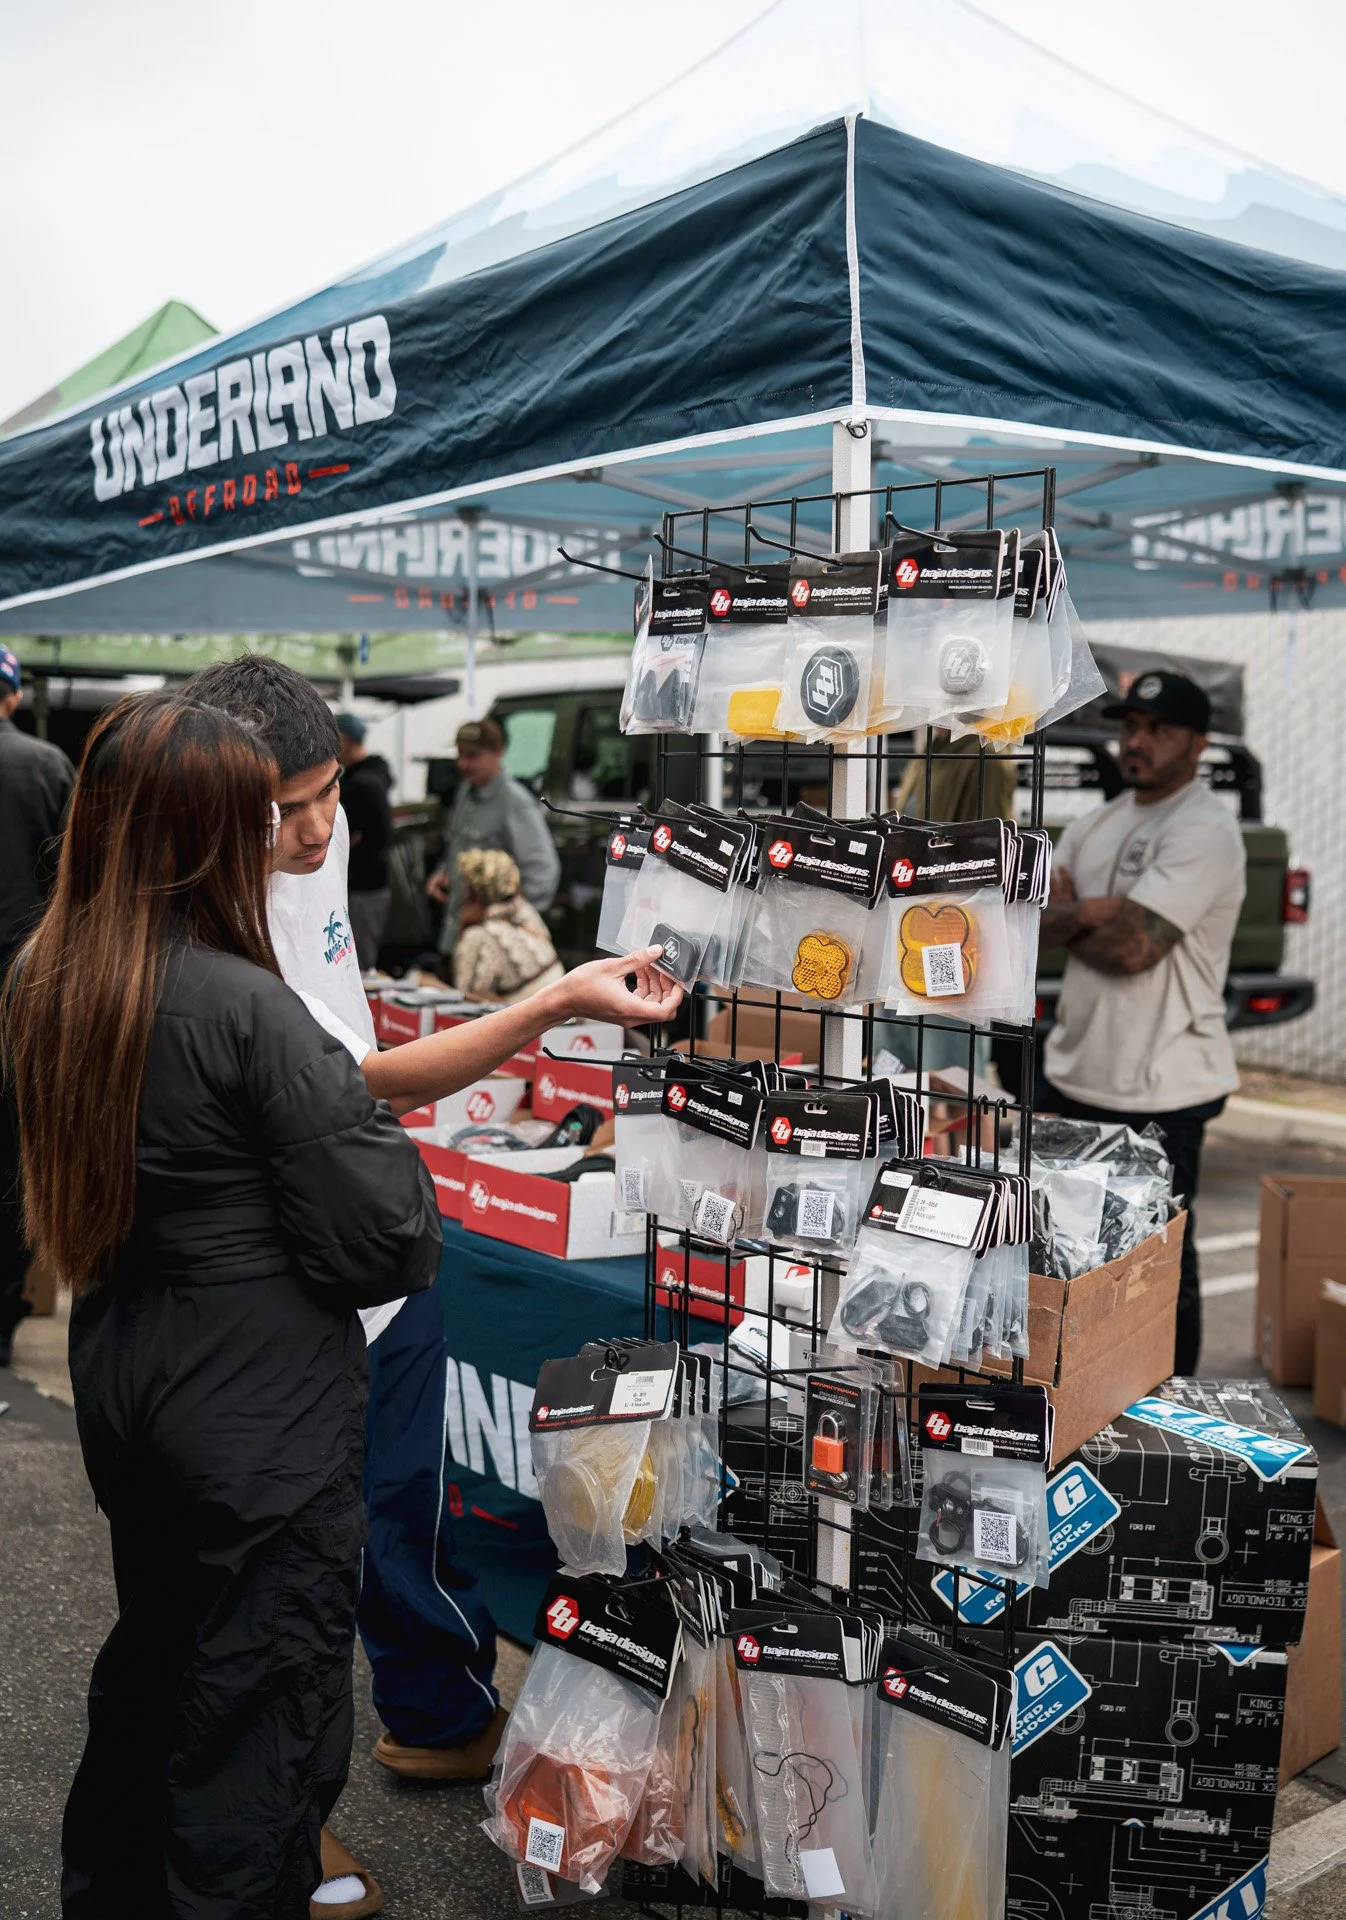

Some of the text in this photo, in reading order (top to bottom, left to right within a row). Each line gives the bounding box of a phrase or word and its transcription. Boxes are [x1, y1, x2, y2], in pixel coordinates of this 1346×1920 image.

[90, 314, 398, 502] UNDERLAND
[169, 462, 303, 525] OFFROAD
[920, 568, 947, 579] baja
[811, 588, 833, 597] baja
[732, 598, 756, 609] baja
[671, 841, 696, 858] baja
[793, 853, 821, 866] baja
[916, 864, 945, 876] baja
[630, 1089, 664, 1101] baja desi
[687, 1099, 710, 1114] baja
[793, 1127, 817, 1139] baja
[953, 1423, 984, 1436] baja
[1280, 1513, 1303, 1525] KING
[1226, 1594, 1286, 1607] TECHNOLOGY
[579, 1620, 619, 1642] baja
[762, 1645, 790, 1657] baja
[908, 1685, 938, 1702] baja
[1249, 1698, 1273, 1710] KING
[1196, 1777, 1256, 1791] TECHNOLOGY
